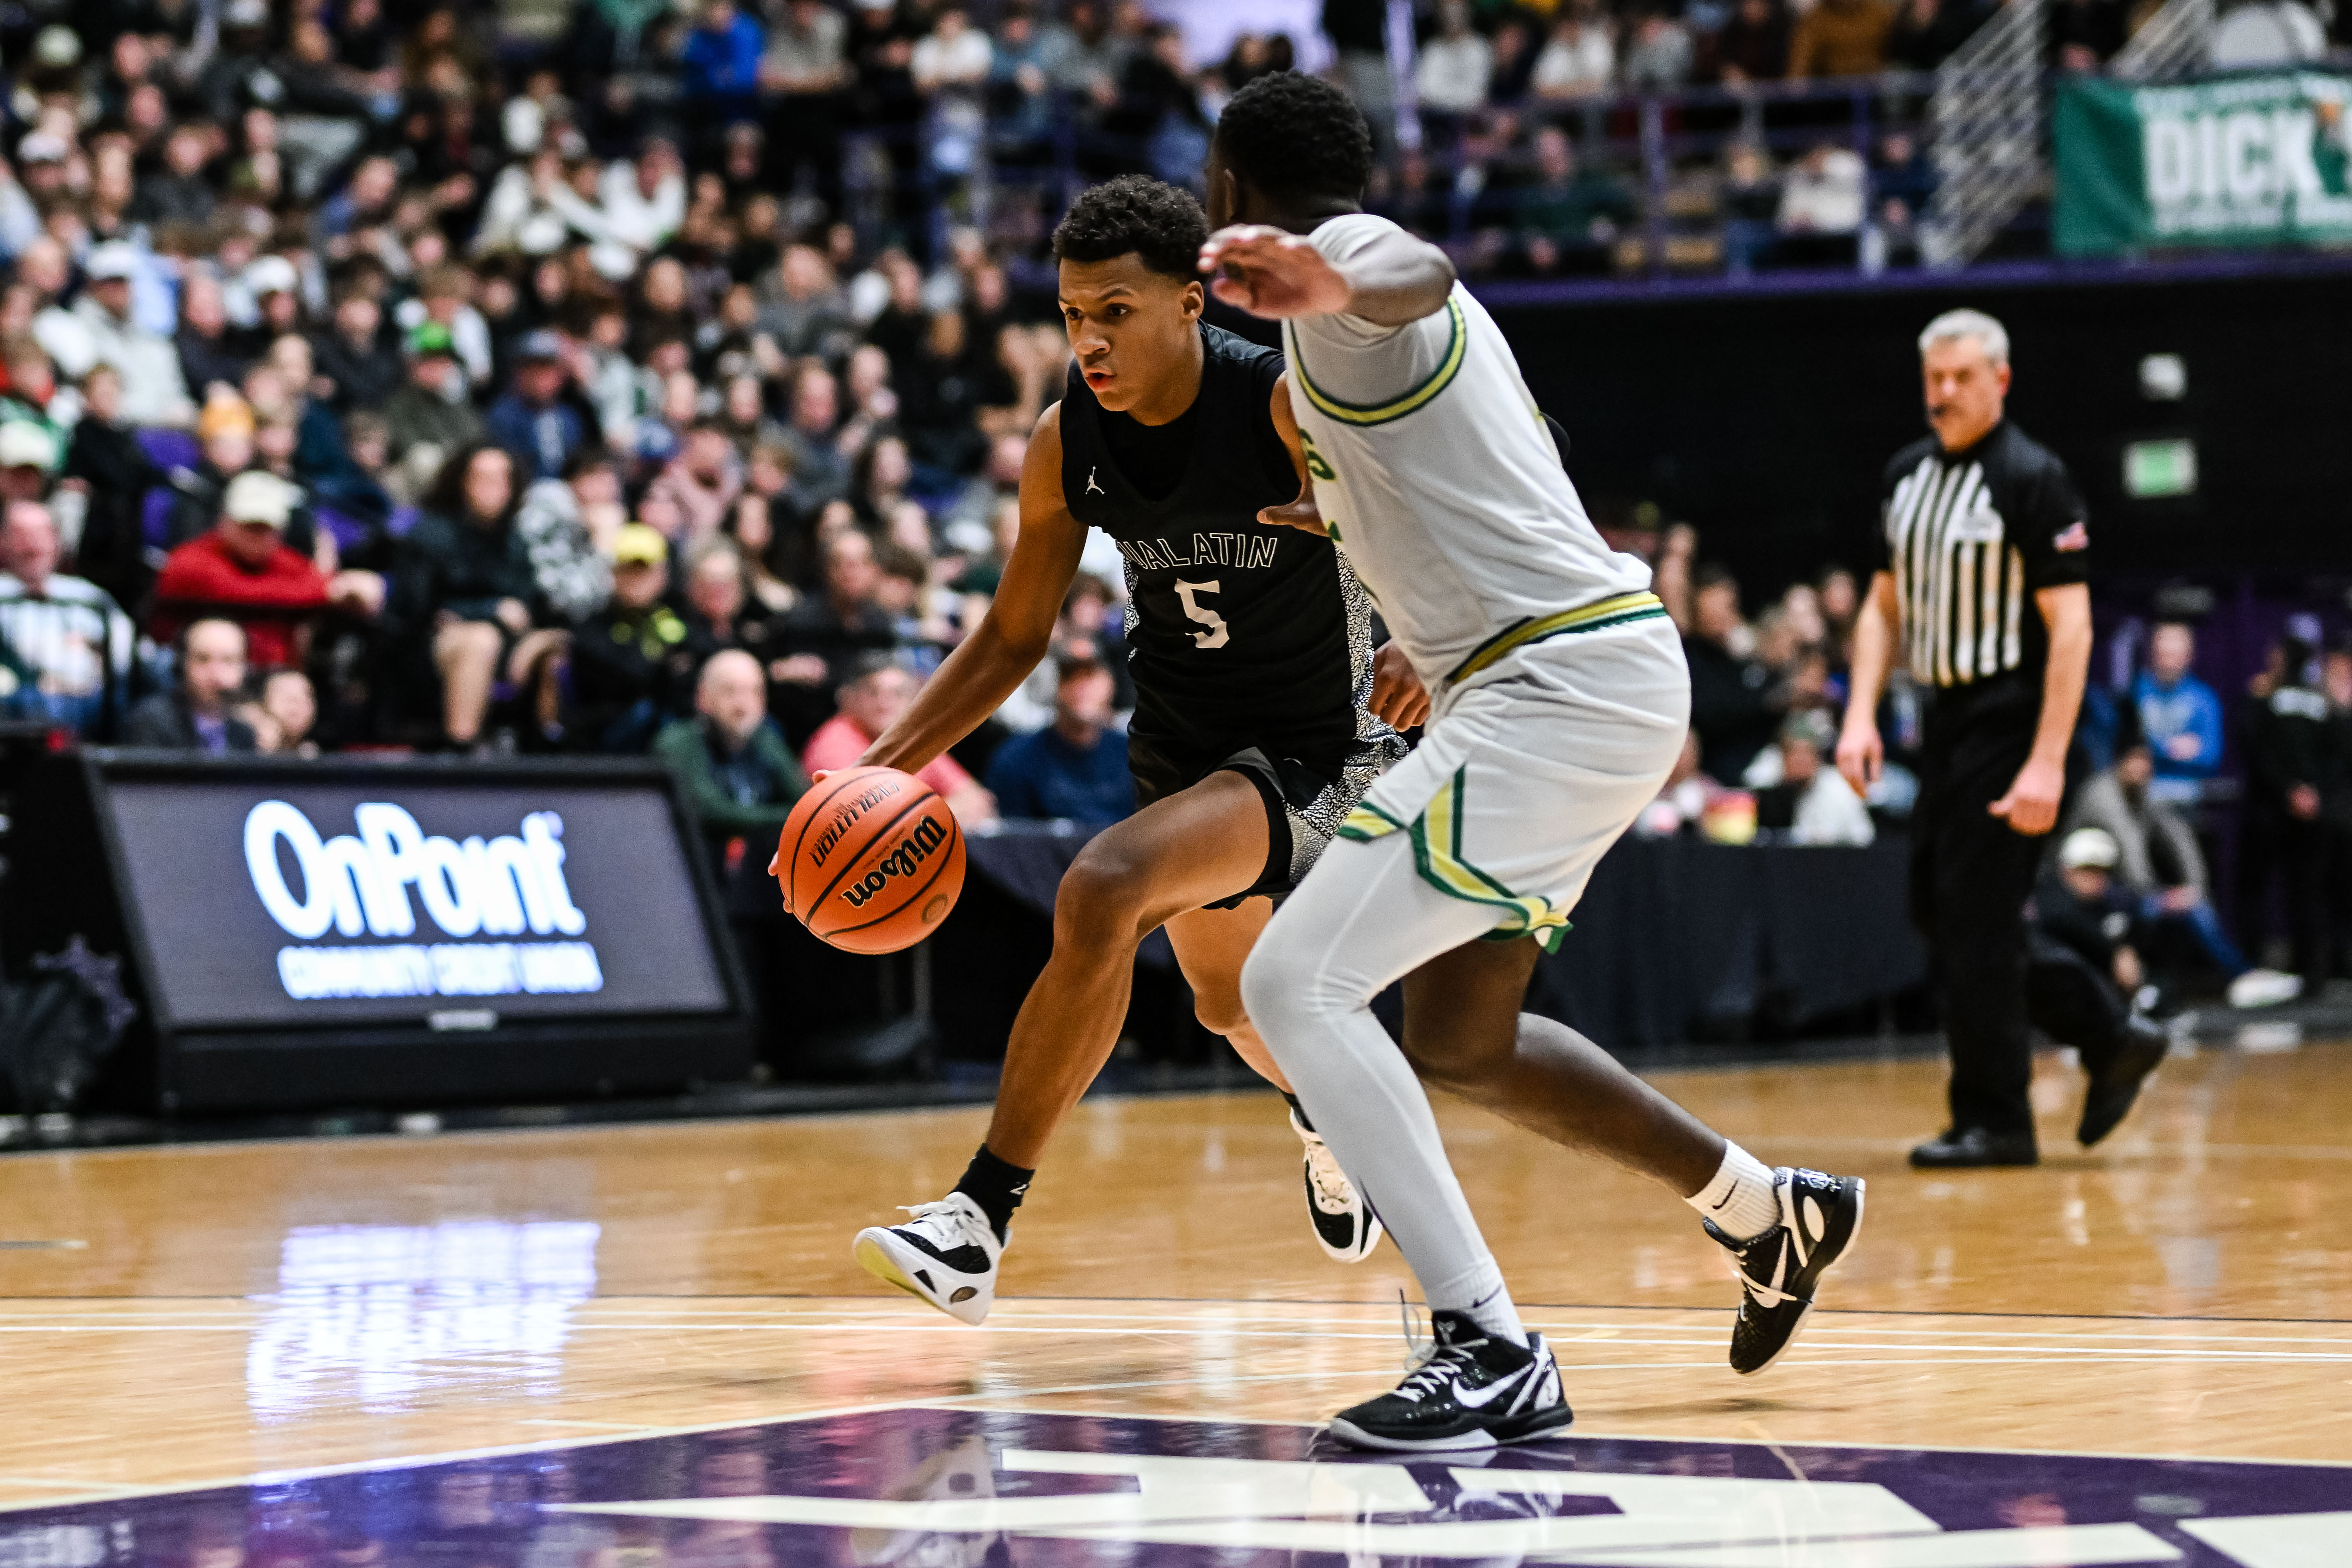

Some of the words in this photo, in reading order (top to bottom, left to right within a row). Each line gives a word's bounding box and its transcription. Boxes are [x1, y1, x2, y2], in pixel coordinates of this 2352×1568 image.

[2145, 109, 2352, 202] DICK
[1116, 532, 1277, 569] UALATIN
[1174, 578, 1230, 649] 5
[244, 799, 587, 939] OnPoint
[809, 779, 900, 868] EVOLUTION
[841, 815, 948, 909] Wilson
